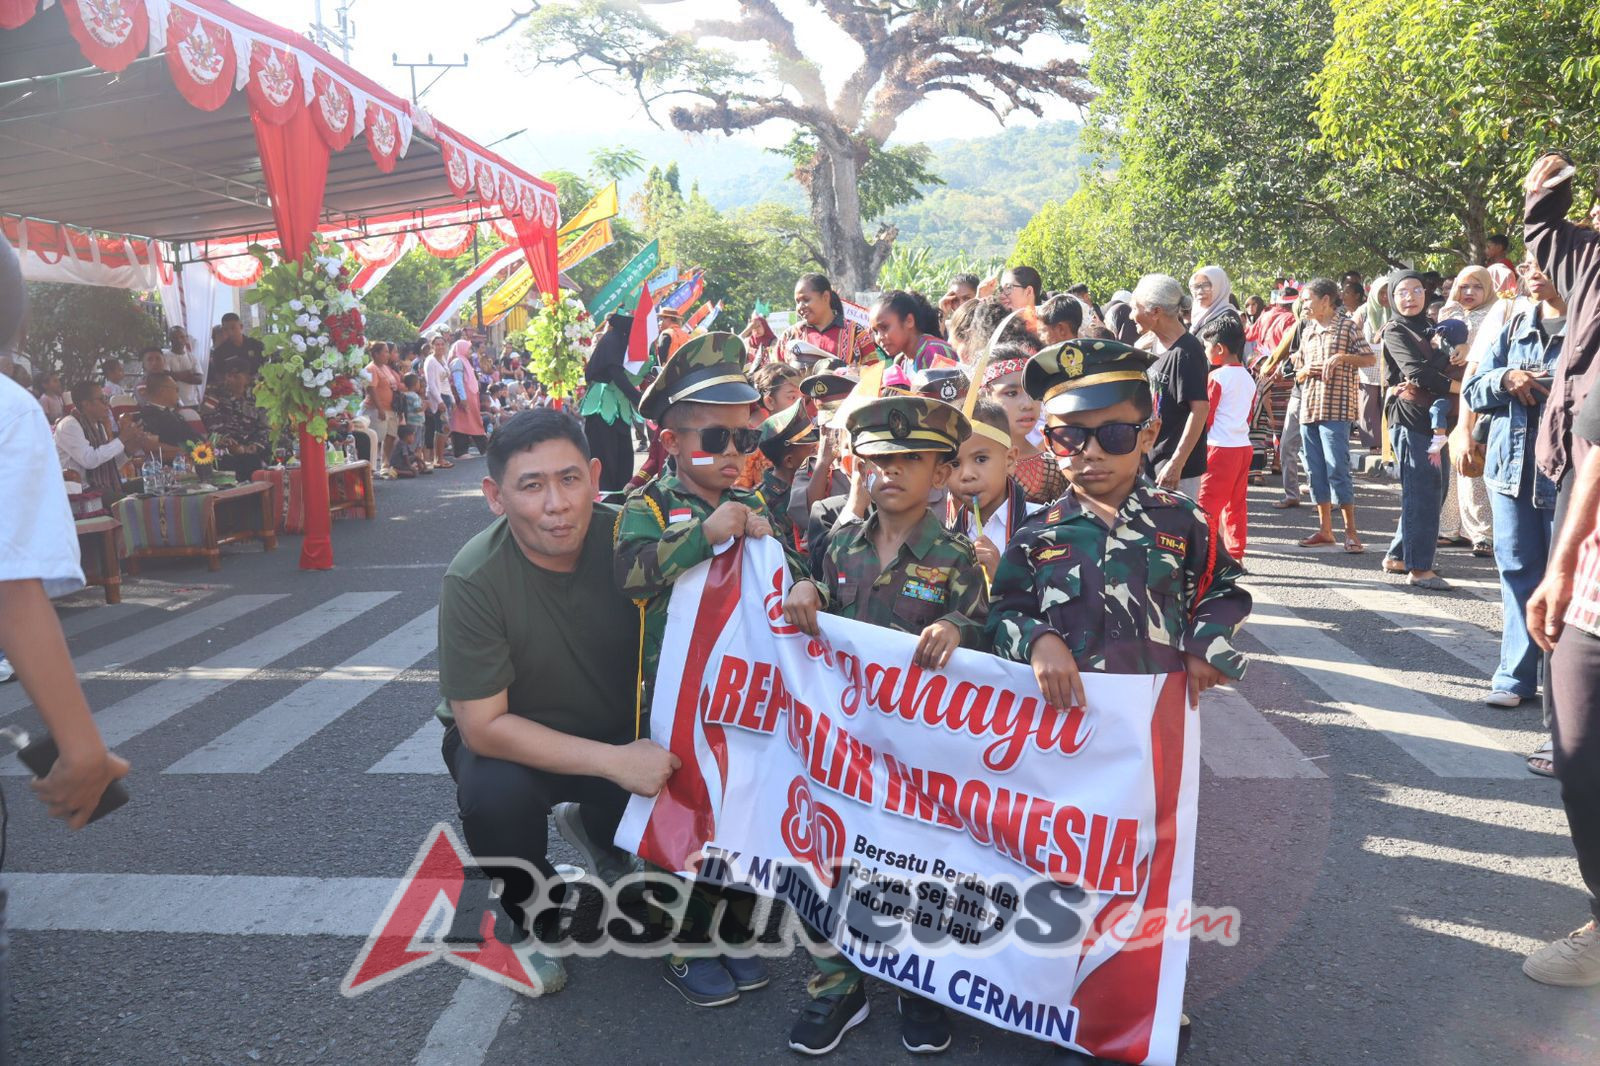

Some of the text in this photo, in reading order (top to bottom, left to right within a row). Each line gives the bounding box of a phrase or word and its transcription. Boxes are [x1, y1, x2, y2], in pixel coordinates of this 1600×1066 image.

[1160, 536, 1185, 552] TNI-A
[764, 566, 1093, 772] gahayu
[882, 752, 1139, 893] INDONESIA
[849, 857, 1005, 932] Rakyat Sejahtera
[853, 834, 1020, 912] Bersatu Berdaulat
[703, 846, 1075, 1043] TK MULTIKULTURAL CERMIN
[845, 880, 982, 945] Indonesia Maju
